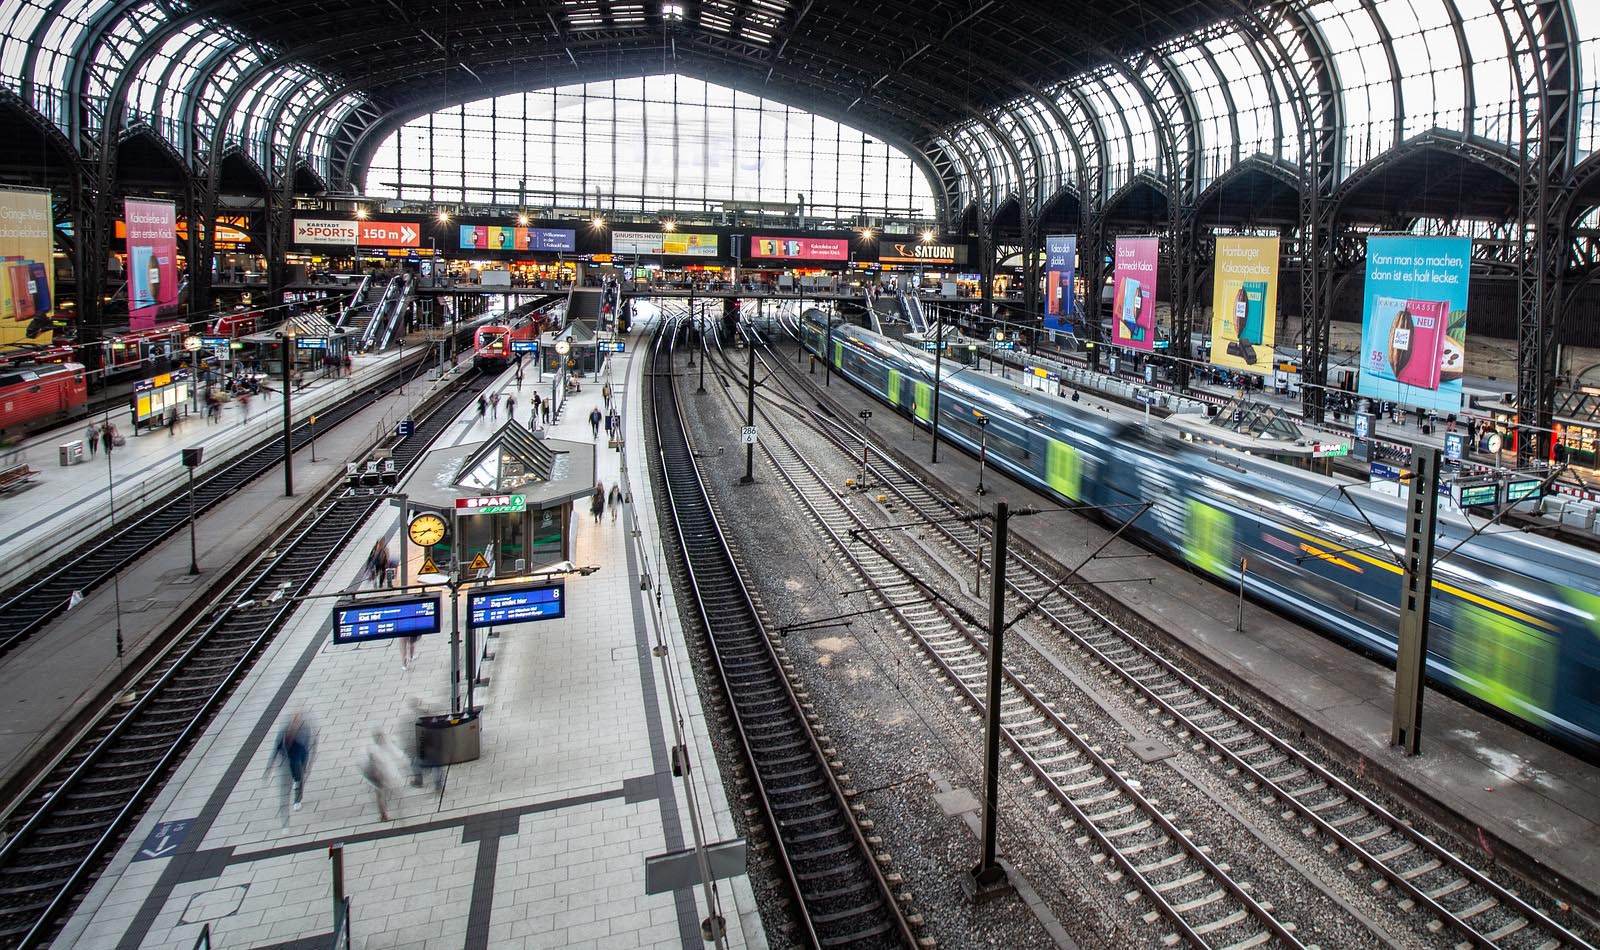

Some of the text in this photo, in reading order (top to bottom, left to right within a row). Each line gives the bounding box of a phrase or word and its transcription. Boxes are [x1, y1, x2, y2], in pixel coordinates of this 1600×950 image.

[306, 227, 355, 238] SPORTS
[363, 228, 399, 240] 150 m
[914, 245, 955, 258] SATURN
[1222, 244, 1260, 260] Hamburger
[1372, 253, 1463, 269] Kann man so machen,
[1371, 268, 1459, 285] dann ist es halt lecker.
[1416, 318, 1433, 327] NEU
[1372, 351, 1383, 361] 55
[399, 422, 408, 434] E
[743, 427, 757, 435] 286
[467, 497, 510, 508] SPAR
[553, 589, 560, 598] 8
[340, 611, 347, 624] 7
